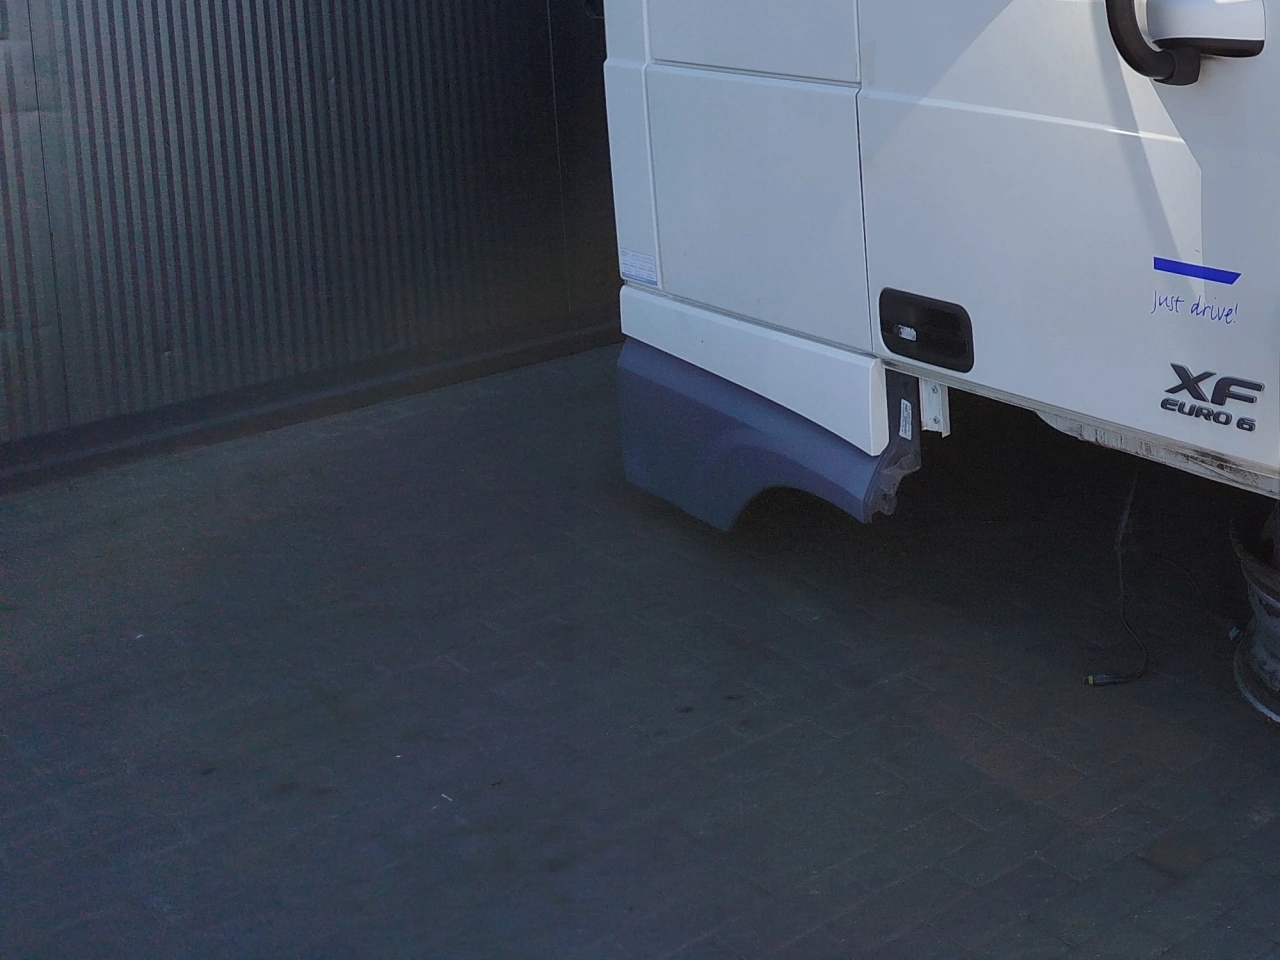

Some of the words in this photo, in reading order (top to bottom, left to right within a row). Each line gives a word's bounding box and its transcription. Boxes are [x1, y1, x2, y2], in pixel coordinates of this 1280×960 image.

[1190, 294, 1239, 325] drive!
[1163, 361, 1266, 407] XF
[1160, 397, 1233, 426] EURO
[1236, 416, 1257, 432] 6
